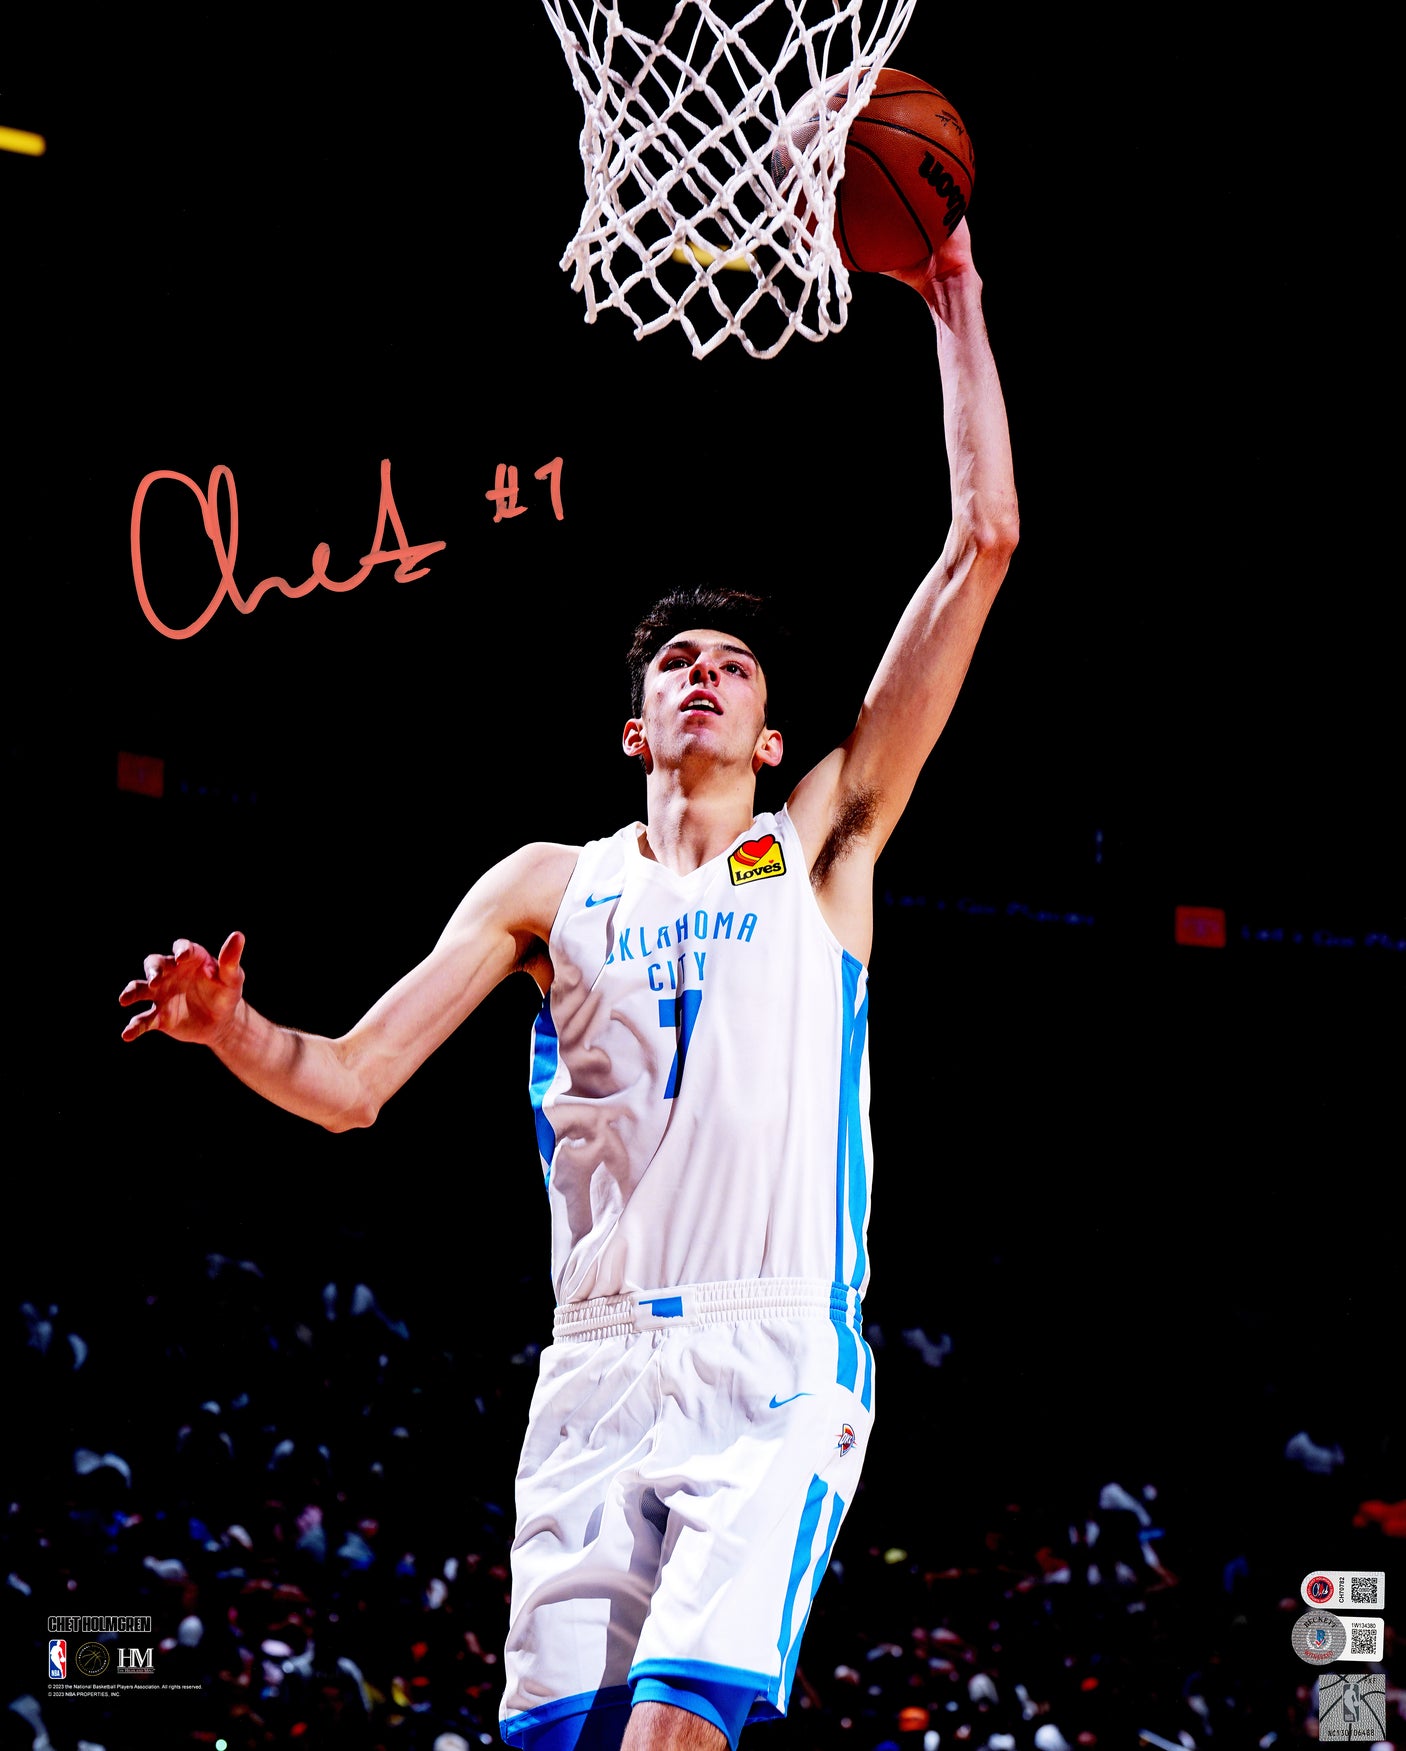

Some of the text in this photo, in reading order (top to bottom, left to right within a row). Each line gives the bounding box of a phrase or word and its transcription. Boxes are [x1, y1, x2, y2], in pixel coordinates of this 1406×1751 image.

[918, 151, 966, 238] lson
[658, 989, 703, 1100] 7
[1303, 1616, 1337, 1628] BECKETT
